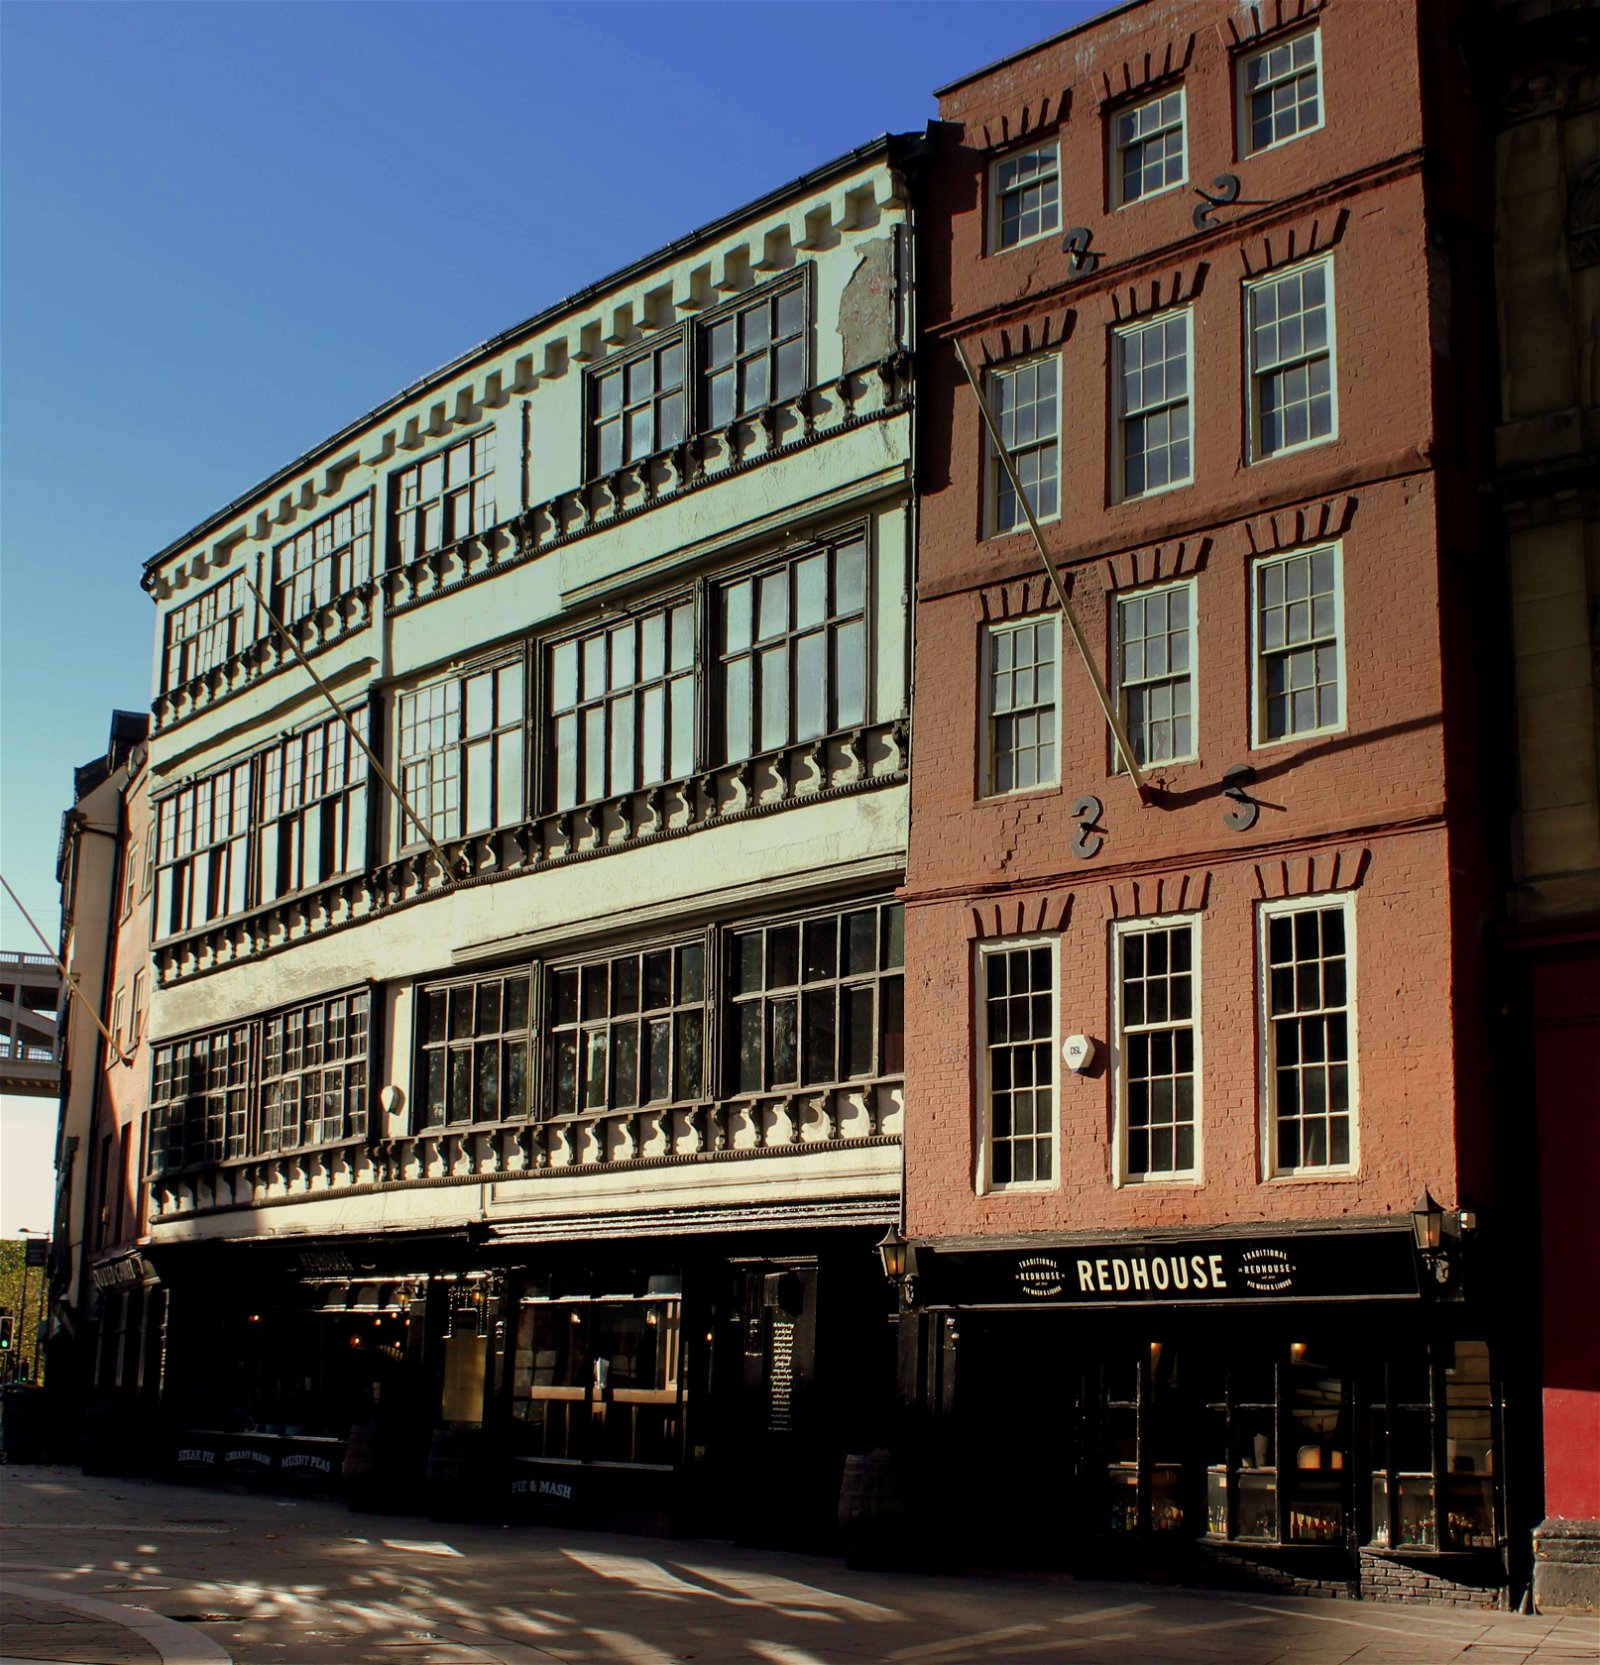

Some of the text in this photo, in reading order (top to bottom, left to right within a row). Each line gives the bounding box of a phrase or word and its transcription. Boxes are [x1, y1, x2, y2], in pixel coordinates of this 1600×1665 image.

[1242, 1249, 1288, 1261] TRADITIONAL
[1018, 1257, 1058, 1269] TRADITIONAL
[1243, 1263, 1291, 1275] REDHOUSE
[1020, 1271, 1061, 1281] REDHOUSE
[1076, 1254, 1229, 1293] REDHOUSE
[177, 1449, 216, 1464] STEAK PIE
[280, 1454, 311, 1468] MUSHY
[311, 1455, 331, 1473] PEAS
[511, 1479, 573, 1499] PIE & MASH
